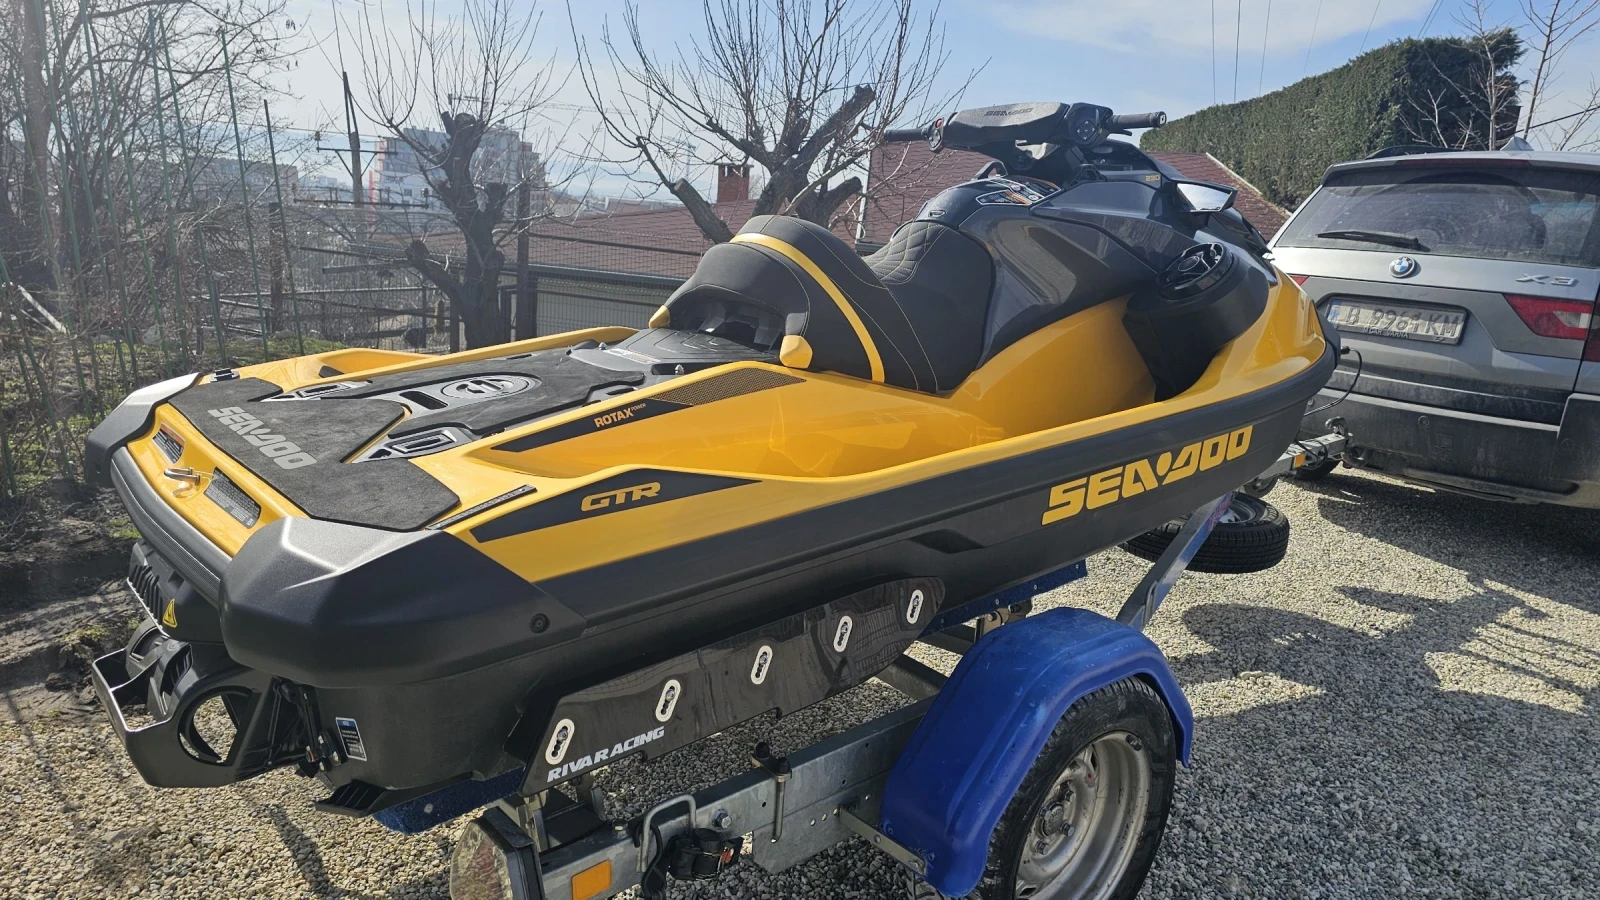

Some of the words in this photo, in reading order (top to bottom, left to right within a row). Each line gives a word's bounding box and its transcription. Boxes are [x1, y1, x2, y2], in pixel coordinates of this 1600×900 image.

[1516, 273, 1577, 286] X3
[1347, 307, 1360, 325] B
[1425, 313, 1459, 337] KM
[594, 408, 634, 427] ROTAX
[631, 403, 647, 411] POWER
[581, 481, 661, 512] GTR
